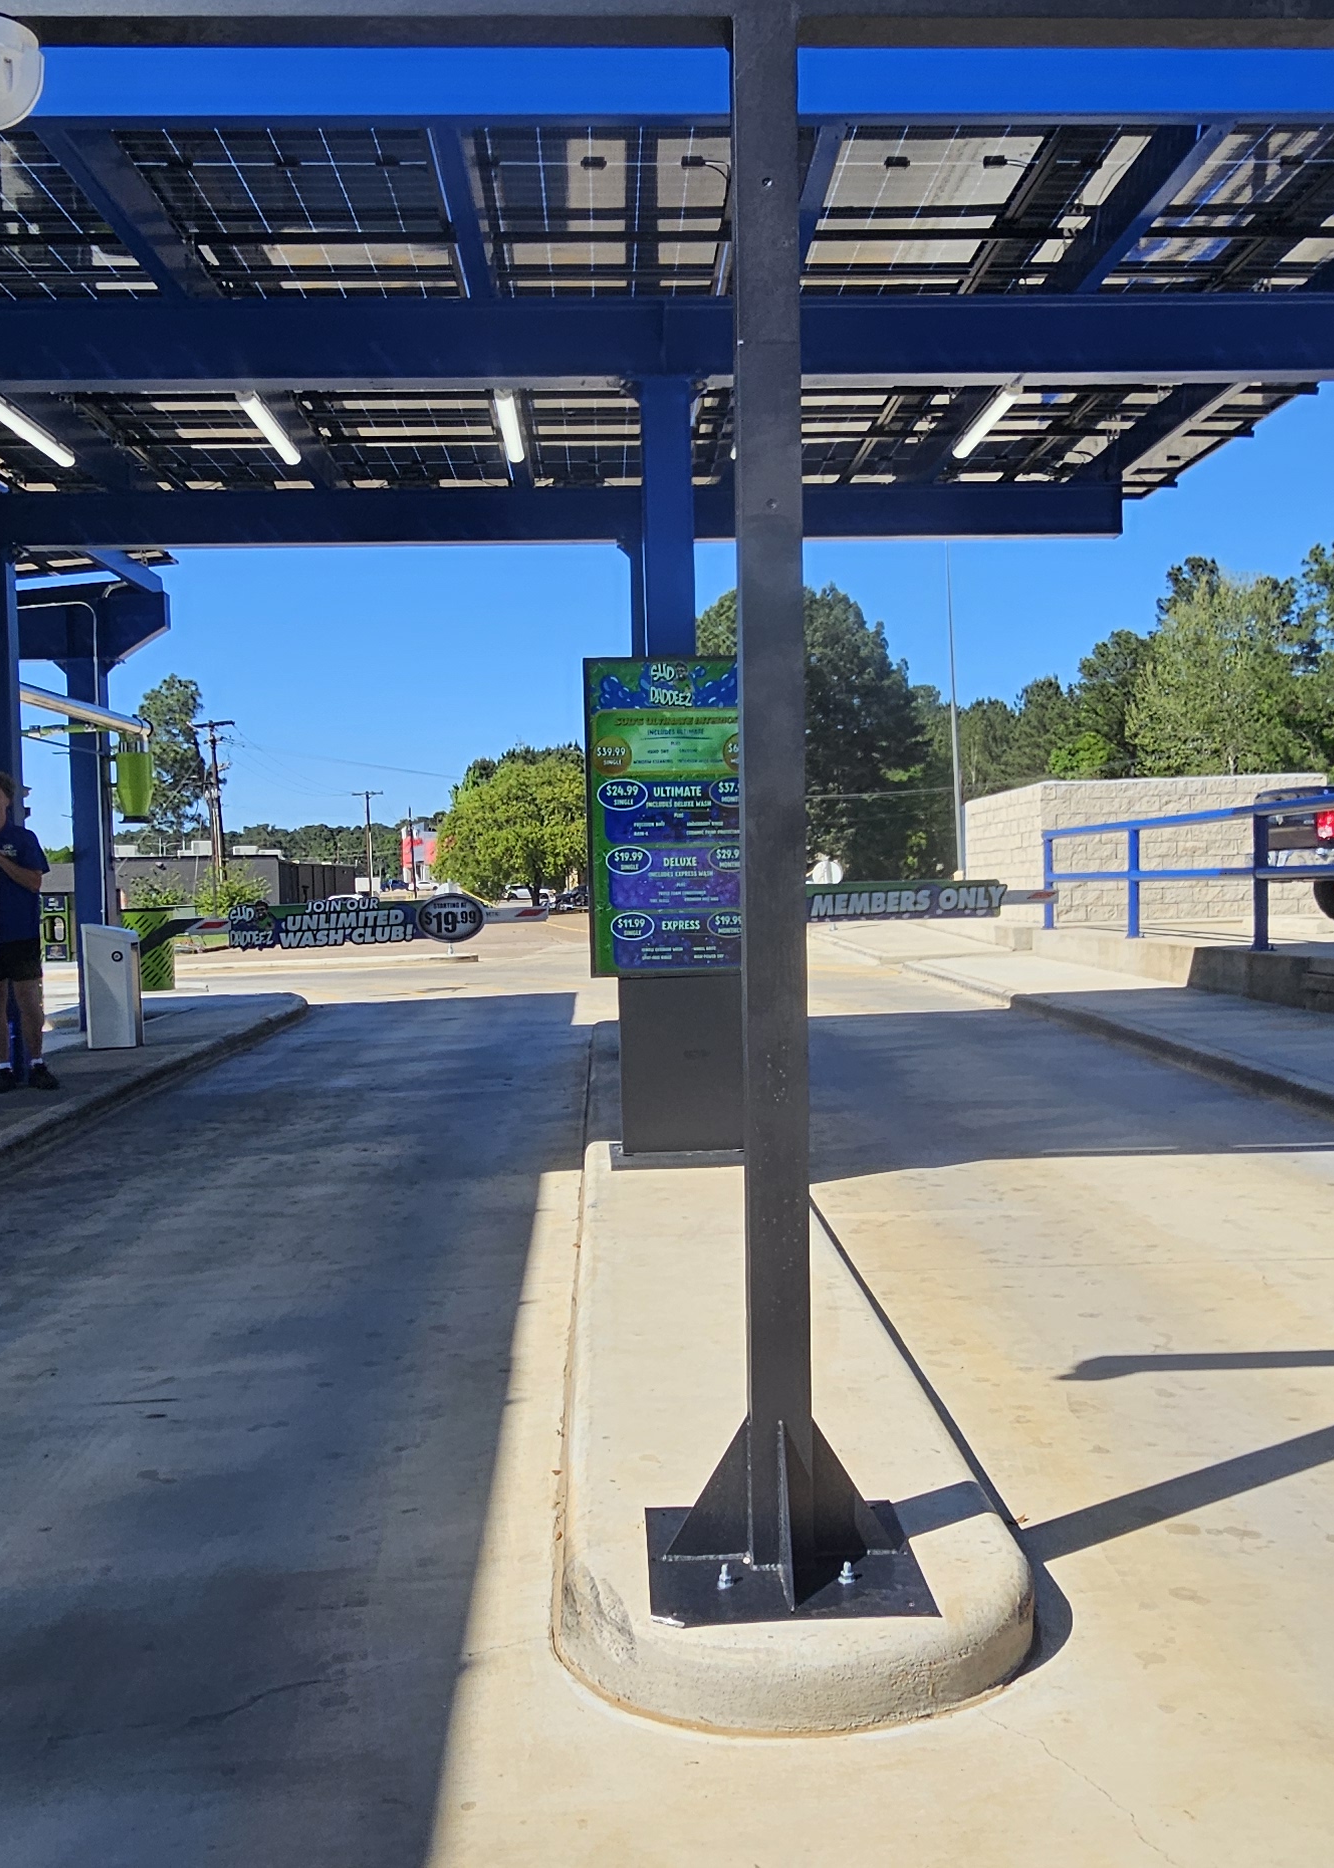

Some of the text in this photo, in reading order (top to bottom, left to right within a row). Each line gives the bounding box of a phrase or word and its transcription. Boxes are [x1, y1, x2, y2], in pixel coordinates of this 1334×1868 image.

[651, 663, 675, 681] SUD
[650, 686, 693, 706] DADDEEZ
[597, 746, 626, 757] $39.99
[606, 785, 639, 797] $24.99
[653, 786, 702, 798] ULTIMATE
[718, 781, 739, 793] $37.
[646, 800, 672, 808] INCLUDES
[614, 851, 643, 862] $19.99
[716, 849, 740, 860] $29.9
[663, 857, 697, 867] DELUXE
[305, 898, 379, 913] JOIN OUR
[810, 885, 1006, 917] MEMBERS ONLY
[229, 906, 255, 924] SUD
[287, 909, 405, 931] UNLIMITED
[424, 910, 477, 933] $19.99
[617, 918, 646, 928] $11.99
[661, 920, 701, 931] EXPRESS
[230, 930, 274, 946] DADDEEZ
[279, 923, 414, 948] WASH CLUB!
